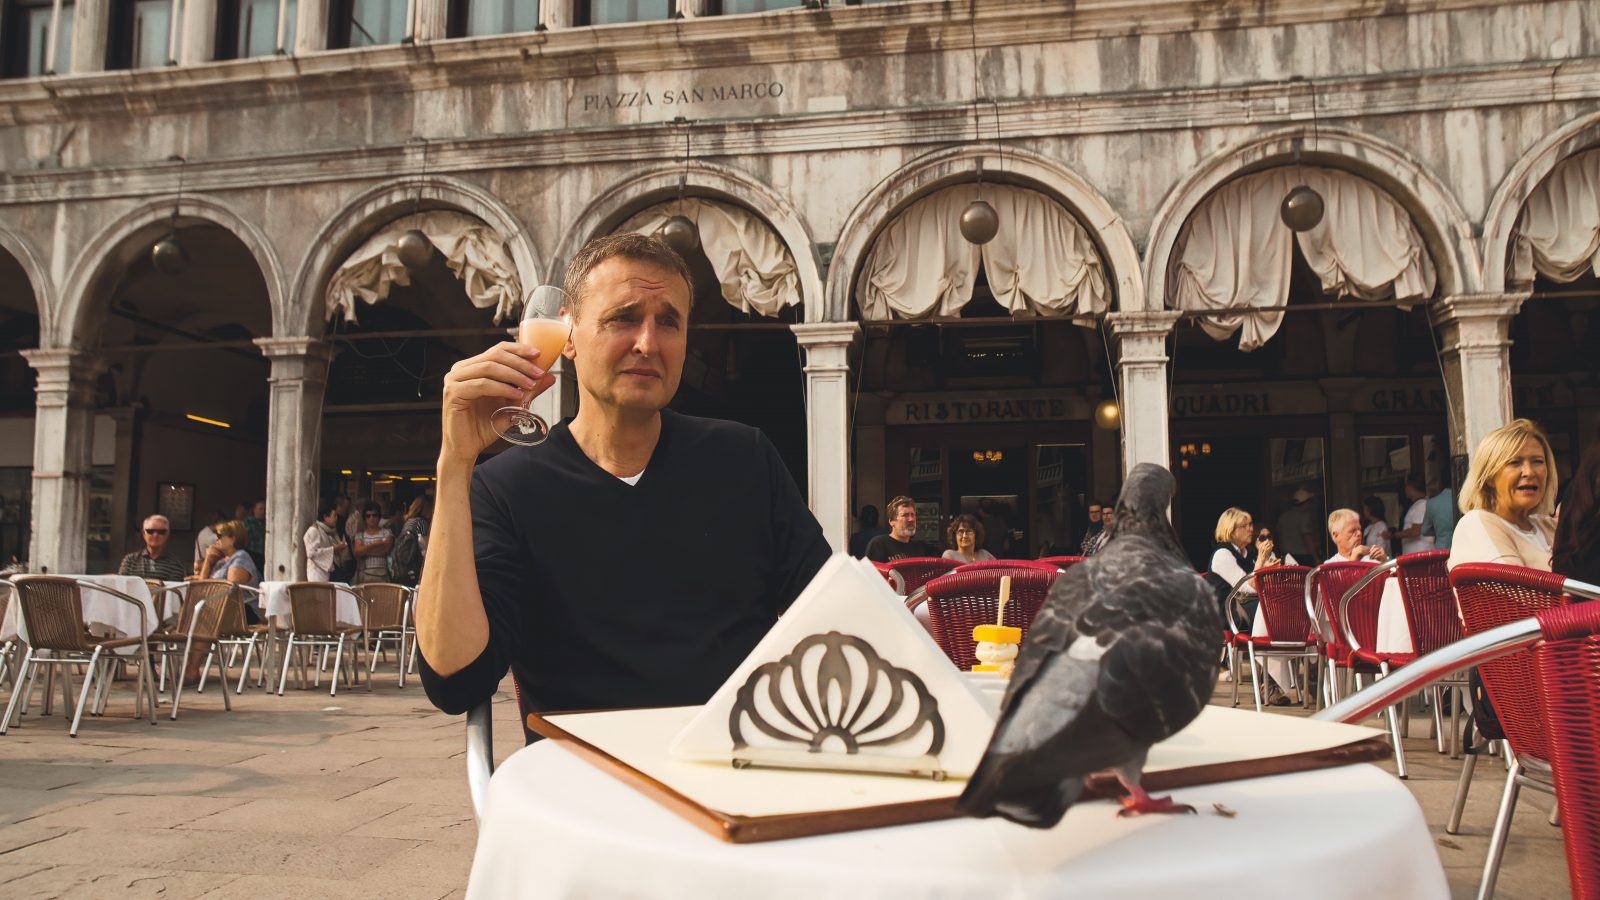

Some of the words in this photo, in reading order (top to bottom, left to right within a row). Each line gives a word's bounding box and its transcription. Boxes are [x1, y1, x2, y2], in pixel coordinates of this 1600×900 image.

[584, 92, 653, 111] PIAZZA
[663, 88, 704, 105] SAN
[711, 82, 784, 101] MARCO
[905, 400, 1065, 421] RISTORANTE
[1173, 393, 1271, 415] QUADRI
